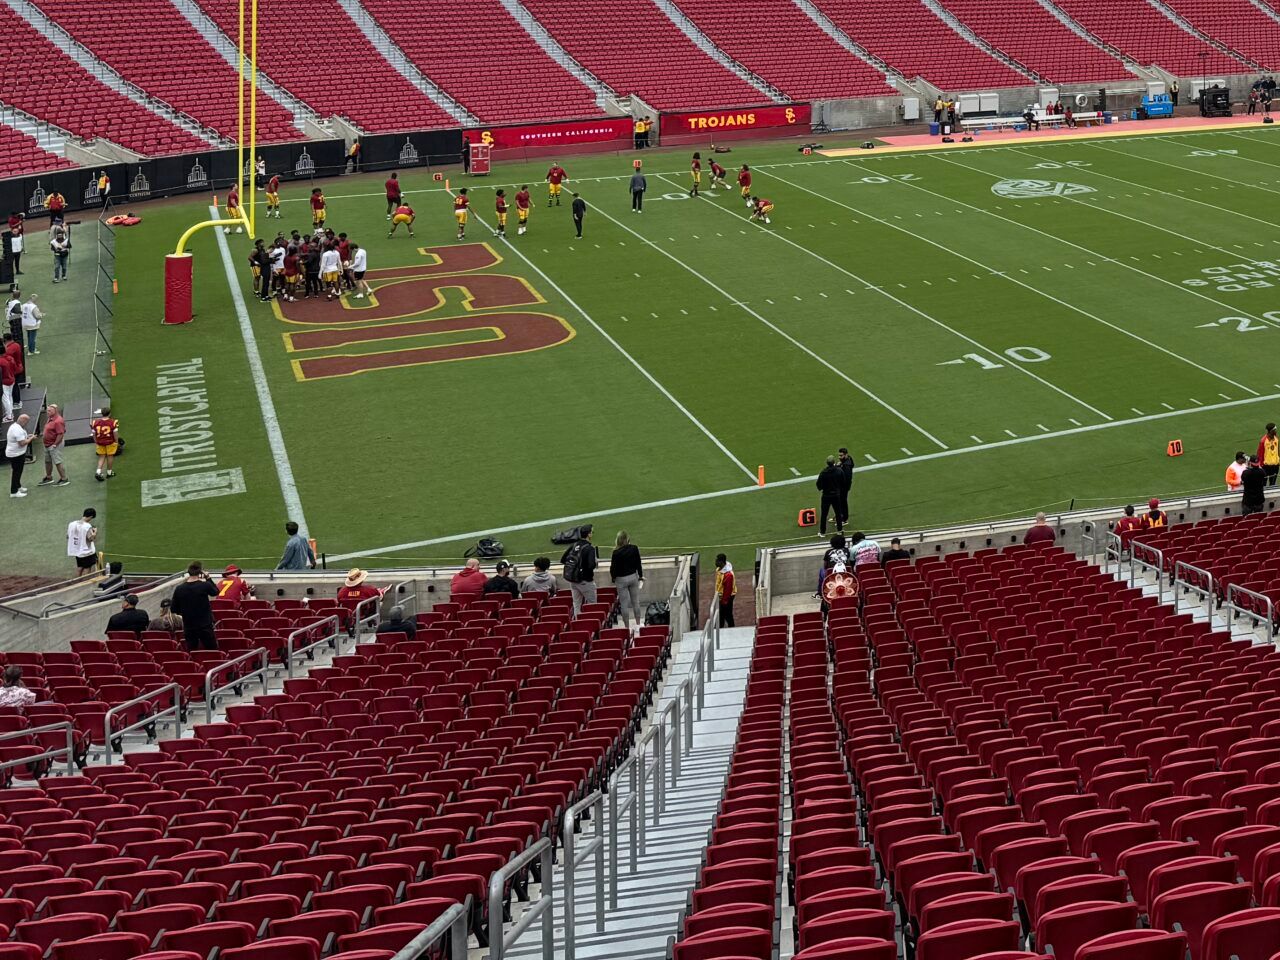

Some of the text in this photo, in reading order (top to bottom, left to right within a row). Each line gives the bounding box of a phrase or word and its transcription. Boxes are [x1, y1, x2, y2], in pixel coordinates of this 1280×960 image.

[688, 113, 756, 129] TROJANS
[785, 108, 796, 124] SC
[481, 130, 495, 149] SC
[520, 127, 613, 140] SOUTHERN CALIFORNIA
[861, 172, 924, 184] 20
[962, 346, 1052, 370] 10
[1170, 441, 1181, 454] 10
[802, 510, 815, 525] G
[218, 580, 234, 597] 7
